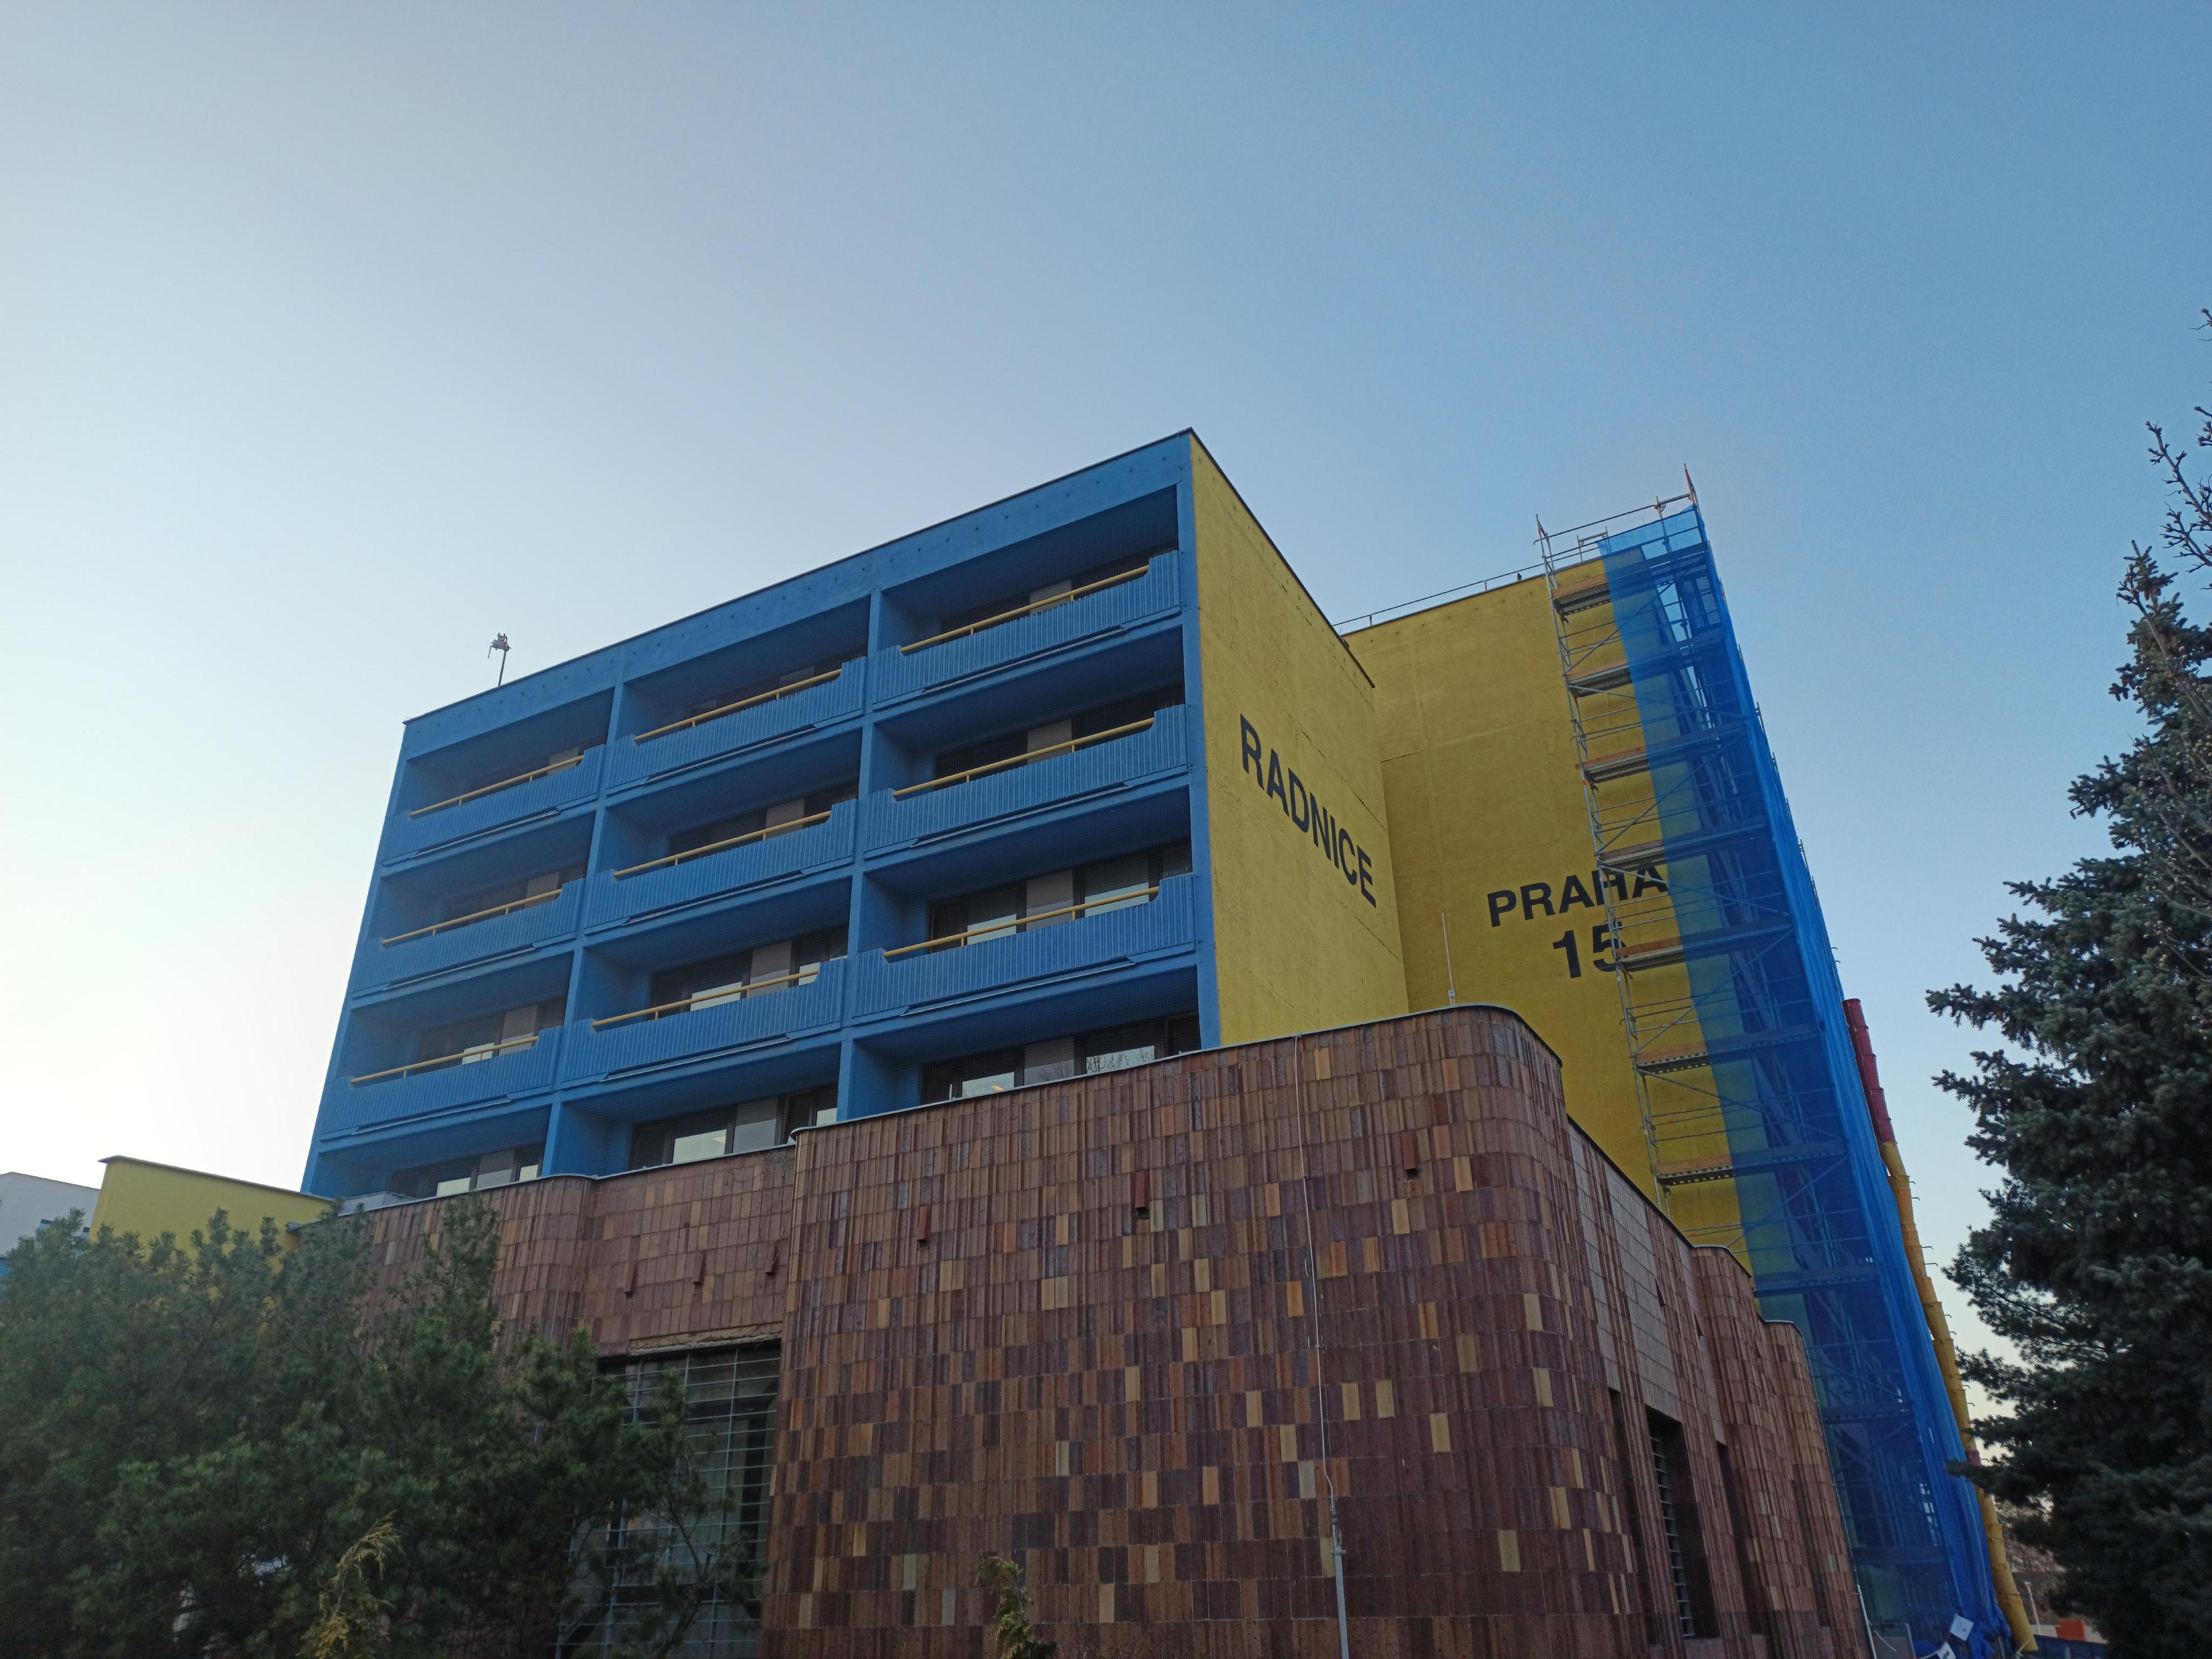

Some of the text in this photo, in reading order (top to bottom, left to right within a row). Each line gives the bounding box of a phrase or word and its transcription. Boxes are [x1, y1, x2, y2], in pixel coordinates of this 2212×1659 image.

[1240, 713, 1376, 908] RADNICE
[1487, 865, 1669, 927] PRAHA
[1553, 921, 1628, 978] 15
